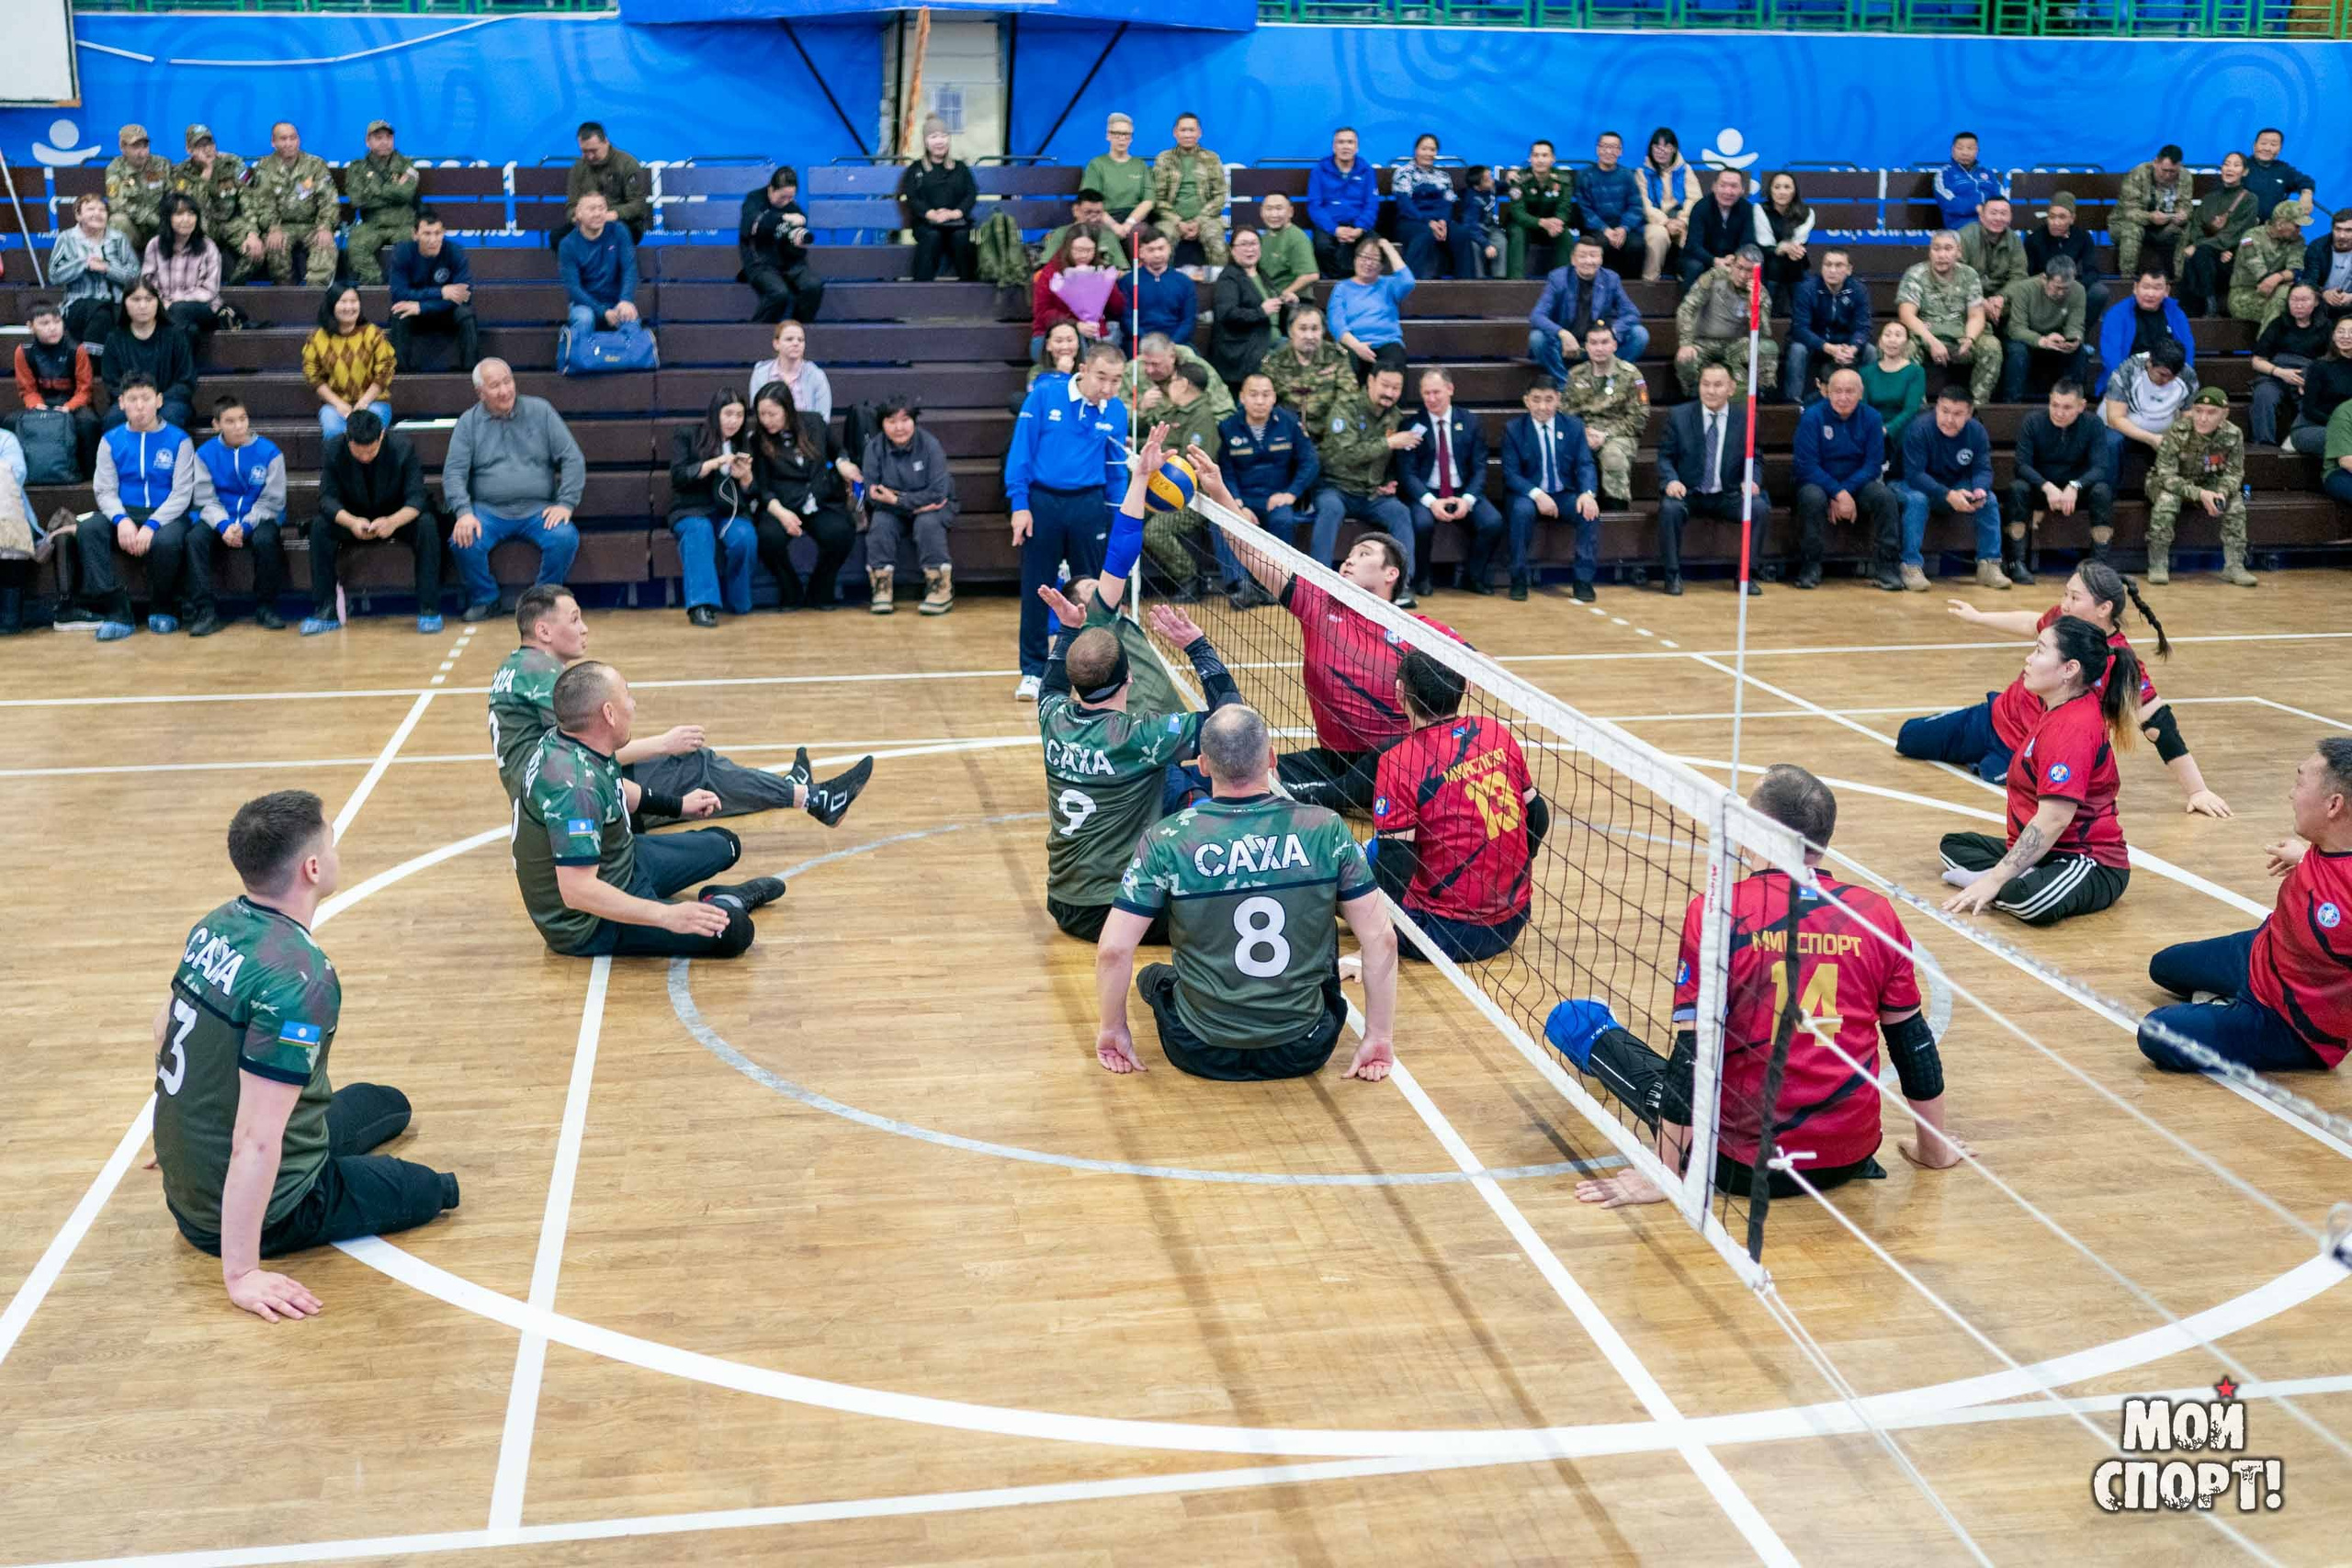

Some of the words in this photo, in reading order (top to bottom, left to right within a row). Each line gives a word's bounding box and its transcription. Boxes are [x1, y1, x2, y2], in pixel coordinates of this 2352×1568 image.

[1046, 739, 1116, 776] САХА
[1057, 788, 1097, 836] 9
[1464, 770, 1521, 840] 13
[1193, 833, 1311, 877] САХА
[184, 928, 245, 996] САХА
[1233, 896, 1292, 978] 8
[1752, 931, 1862, 957] МИСПОРТ
[1770, 960, 1843, 1047] 14
[158, 998, 198, 1096] 3
